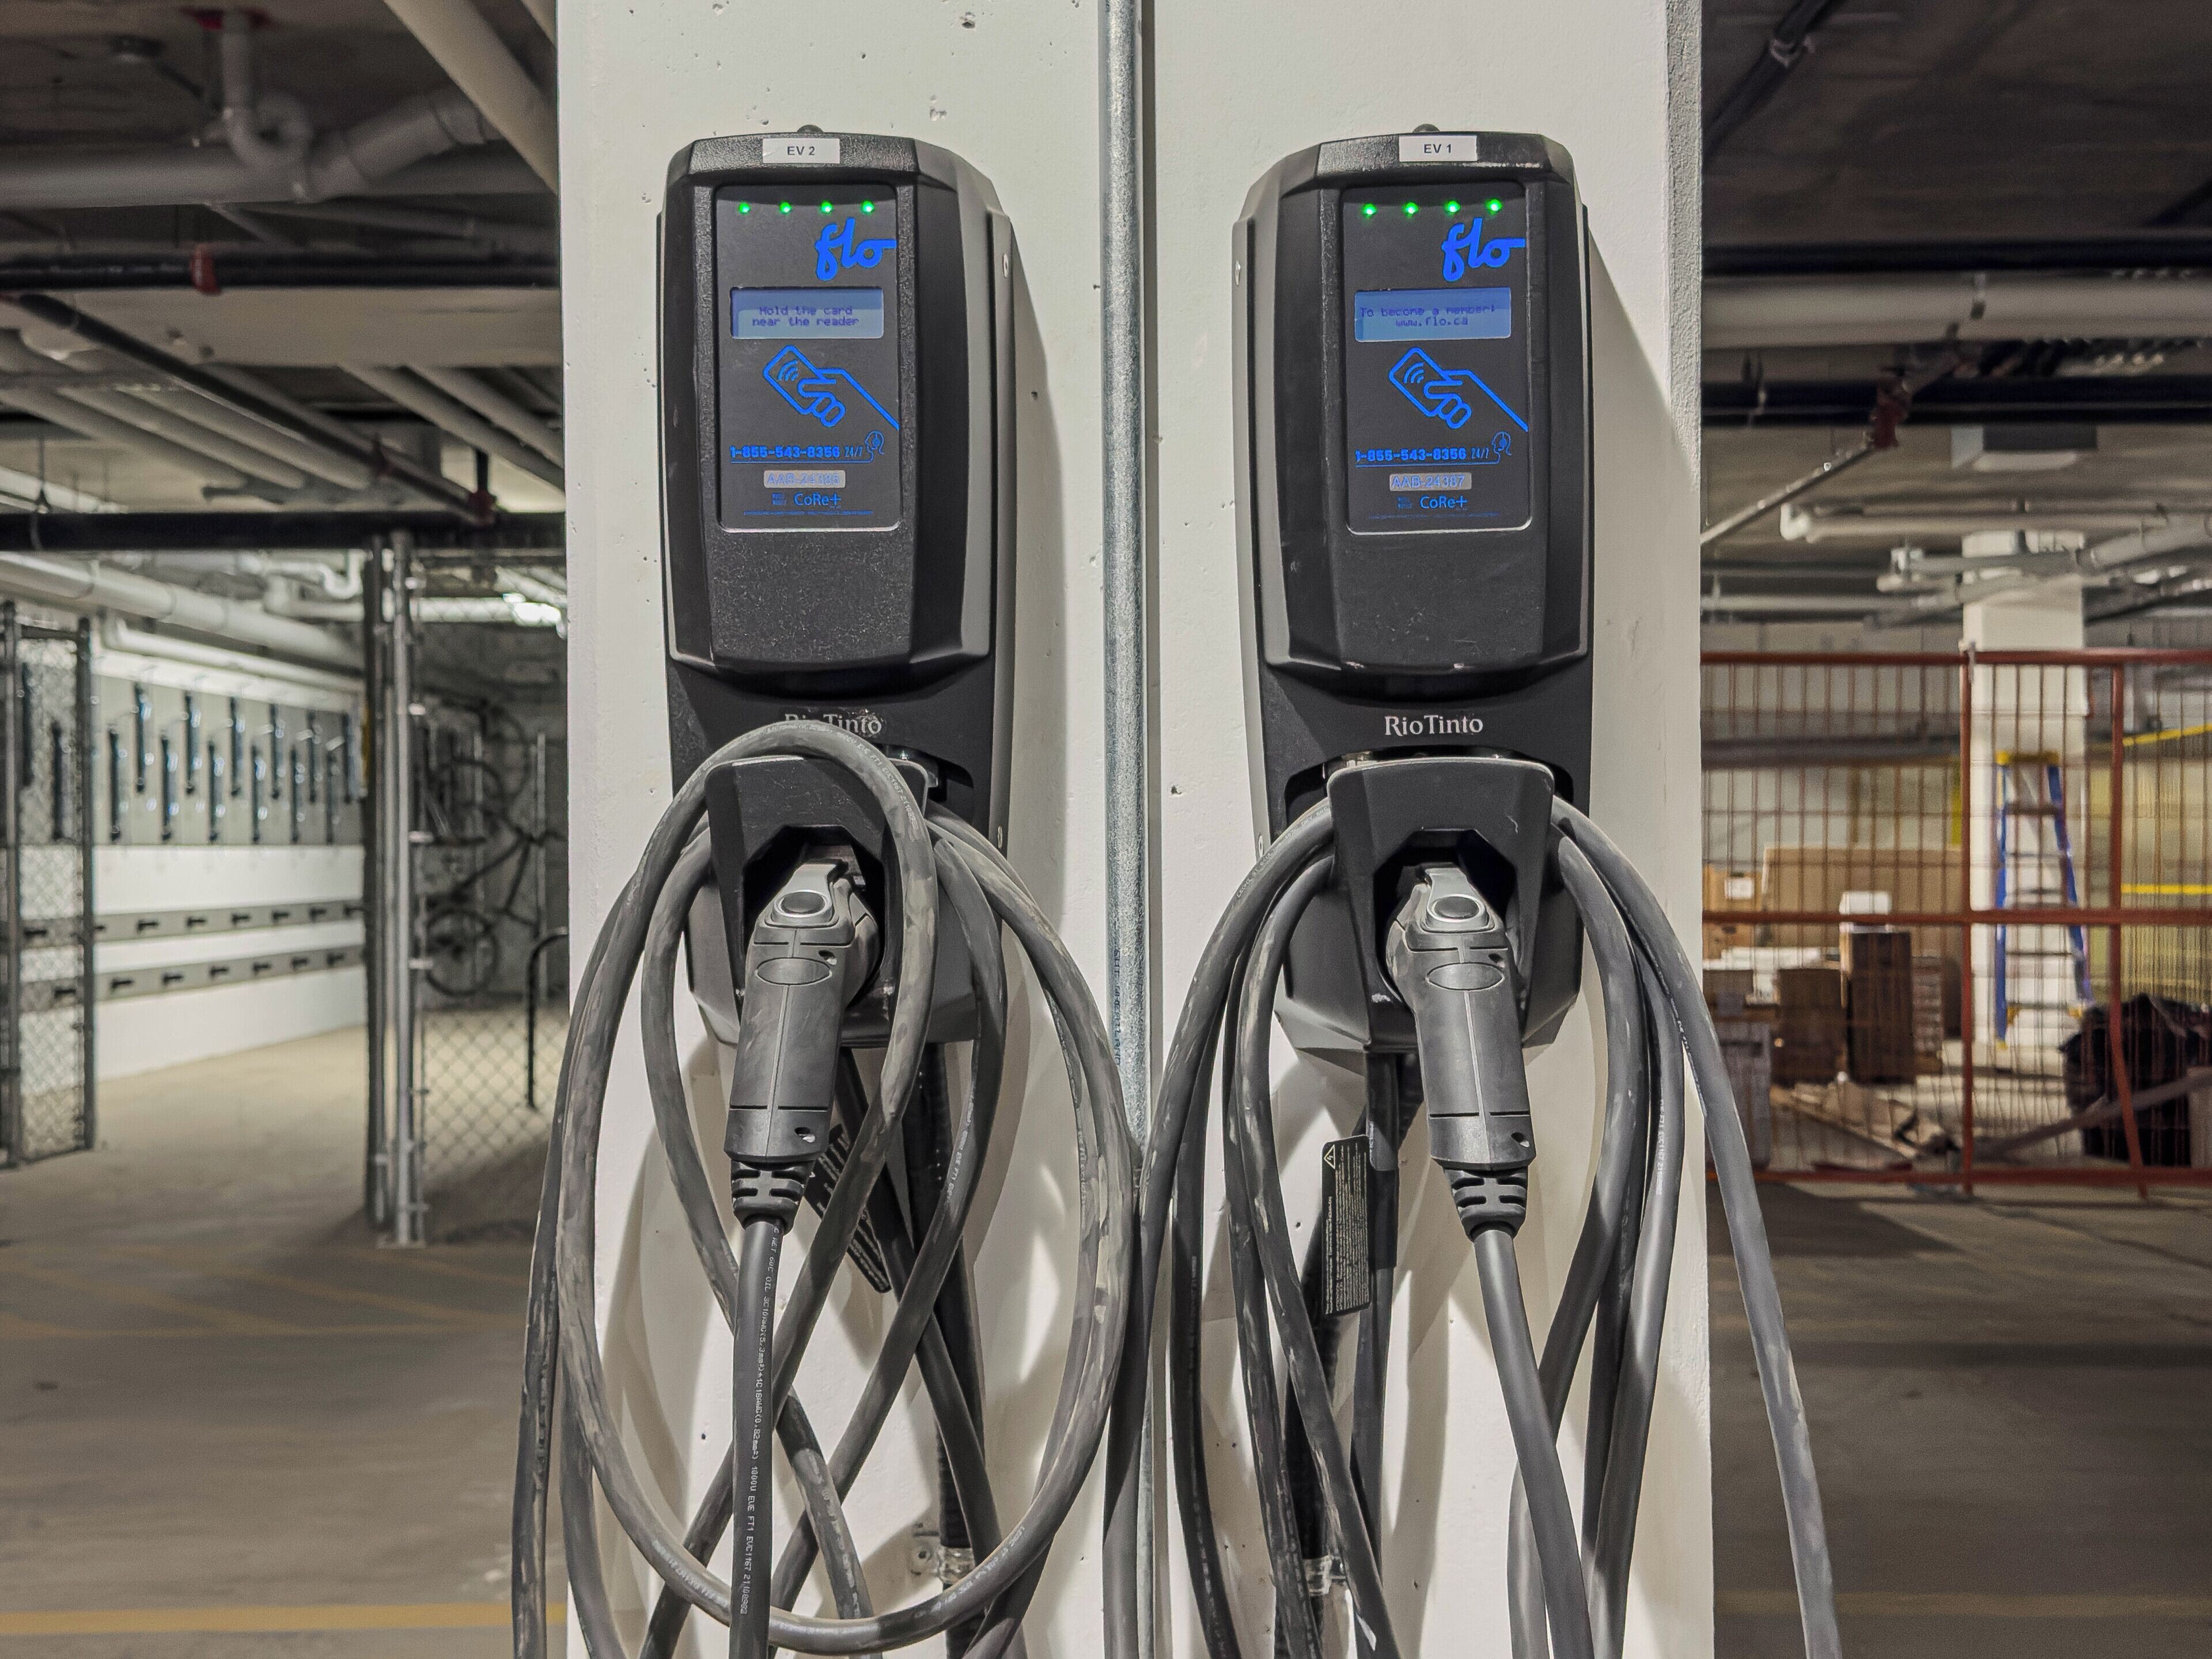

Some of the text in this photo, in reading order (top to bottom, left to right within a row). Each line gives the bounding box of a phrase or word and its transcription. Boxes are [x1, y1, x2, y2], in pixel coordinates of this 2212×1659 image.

[787, 146, 815, 156] EV 2
[1424, 143, 1451, 153] EV 1
[815, 218, 897, 281] flo
[1441, 217, 1525, 281] flo
[758, 306, 853, 316] Hold the card
[1360, 307, 1374, 317] To
[1381, 307, 1425, 316] become
[752, 316, 860, 327] near the reader
[1396, 317, 1469, 327] www.flo.ca
[1355, 447, 1467, 461] 1-855-543-8356
[1391, 475, 1466, 488] AAB-24387
[785, 713, 882, 735] Tinto
[746, 1516, 755, 1531] FT1
